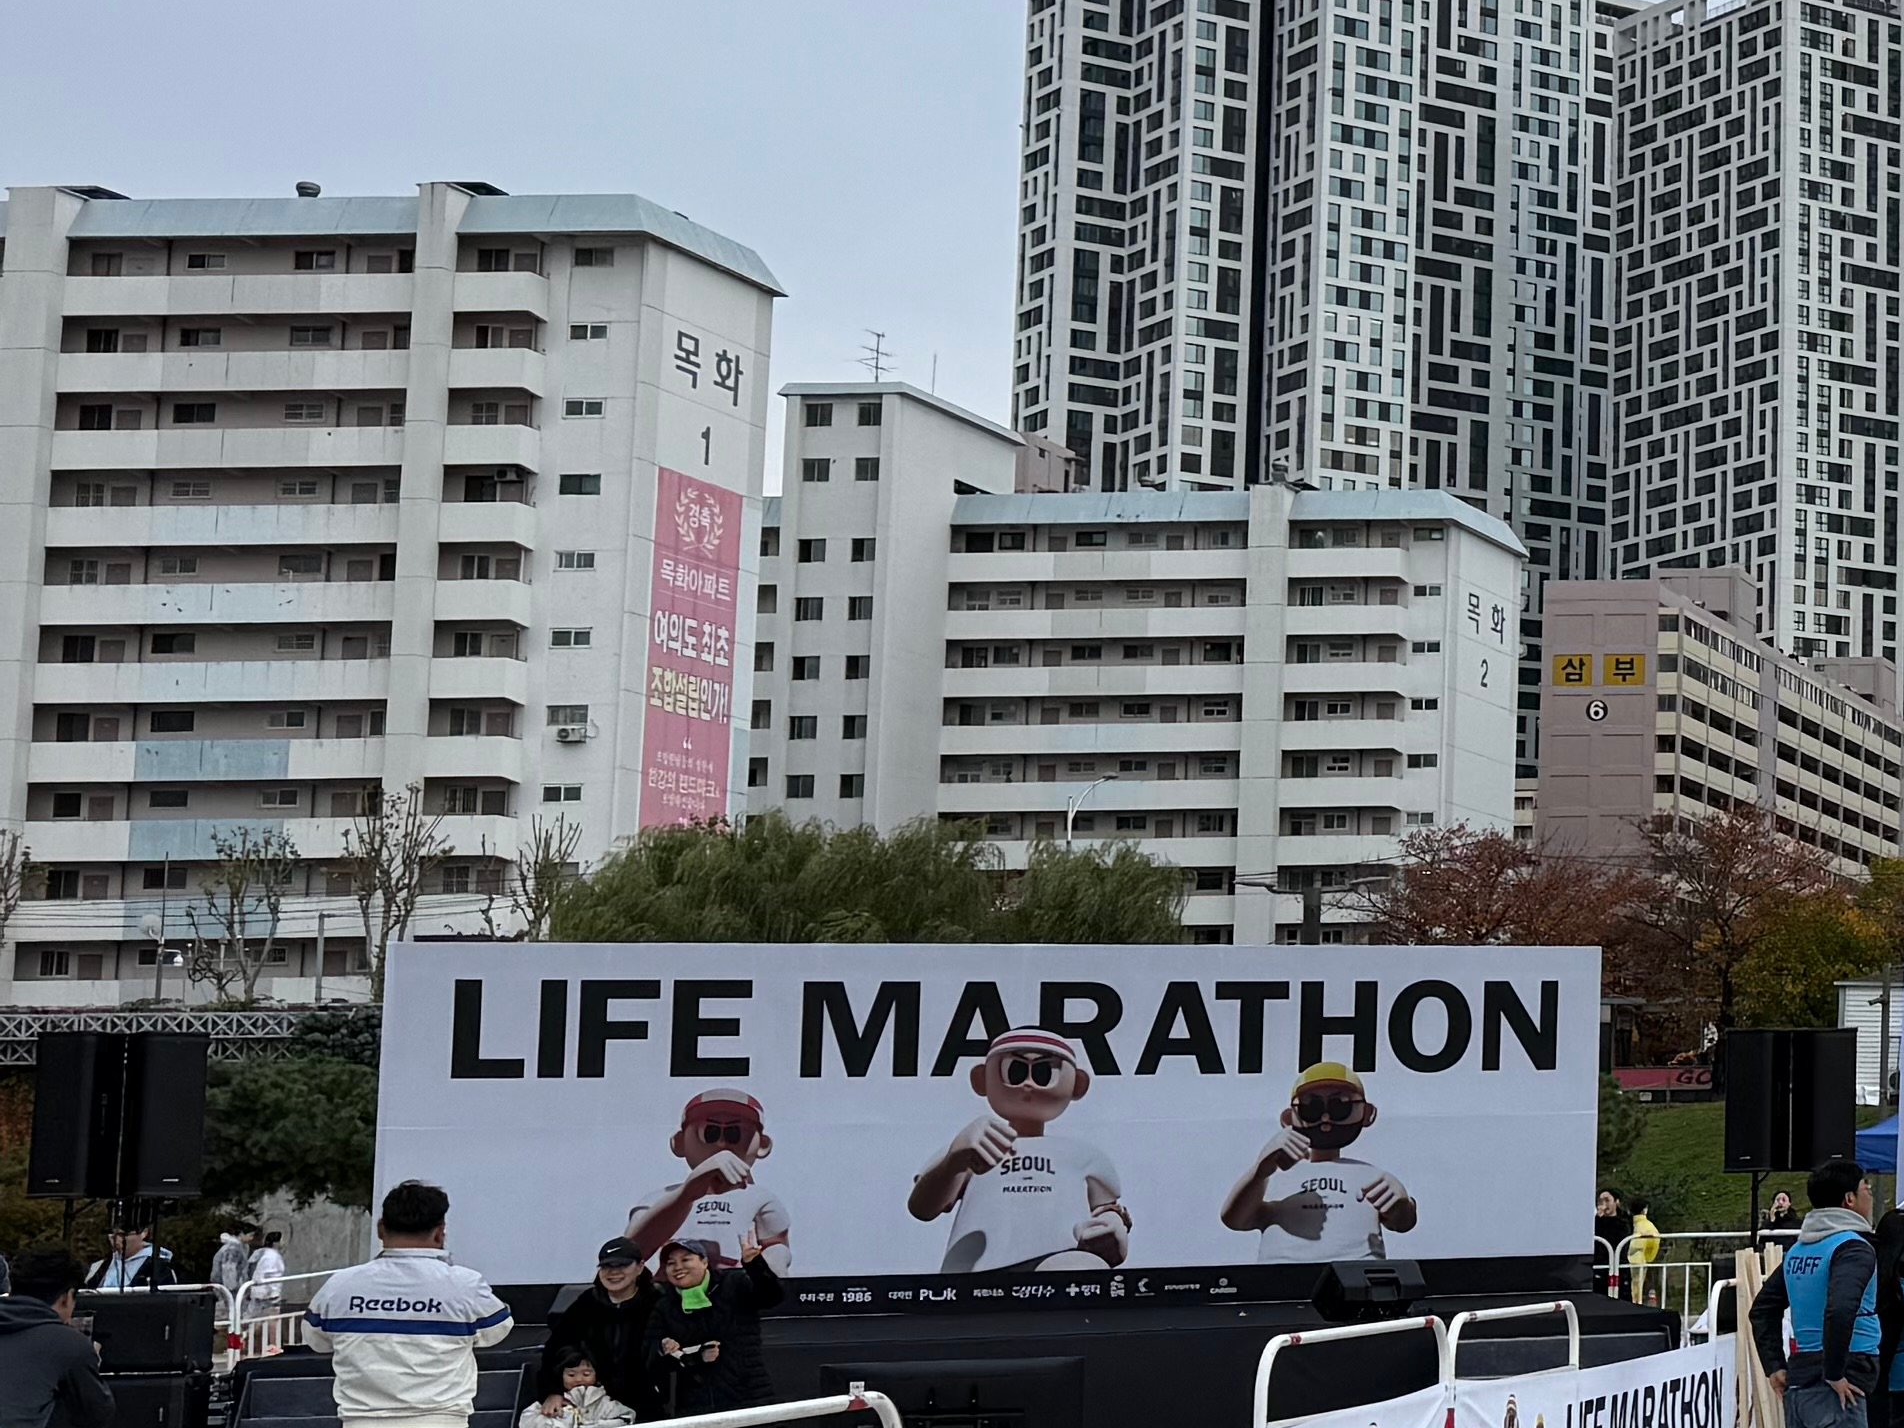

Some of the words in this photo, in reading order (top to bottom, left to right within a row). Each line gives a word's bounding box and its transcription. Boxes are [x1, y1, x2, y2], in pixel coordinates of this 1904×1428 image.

[673, 329, 744, 407] 목화
[701, 426, 711, 466] 1
[660, 558, 731, 601] 목화아파트
[1467, 592, 1506, 645] 목화
[654, 610, 698, 658] 여의도
[700, 621, 729, 667] 최초
[1480, 659, 1489, 688] 2
[650, 667, 728, 724] 조합설립인가!
[450, 978, 754, 1080] LIFE
[799, 977, 1561, 1079] MARATHON
[1000, 1155, 1056, 1177] SEOUL
[1301, 1177, 1348, 1196] SEOUL
[696, 1200, 734, 1214] SEOUL
[1787, 1256, 1822, 1275] STAFF
[349, 1295, 442, 1314] Reebok
[842, 1291, 873, 1302] 1986
